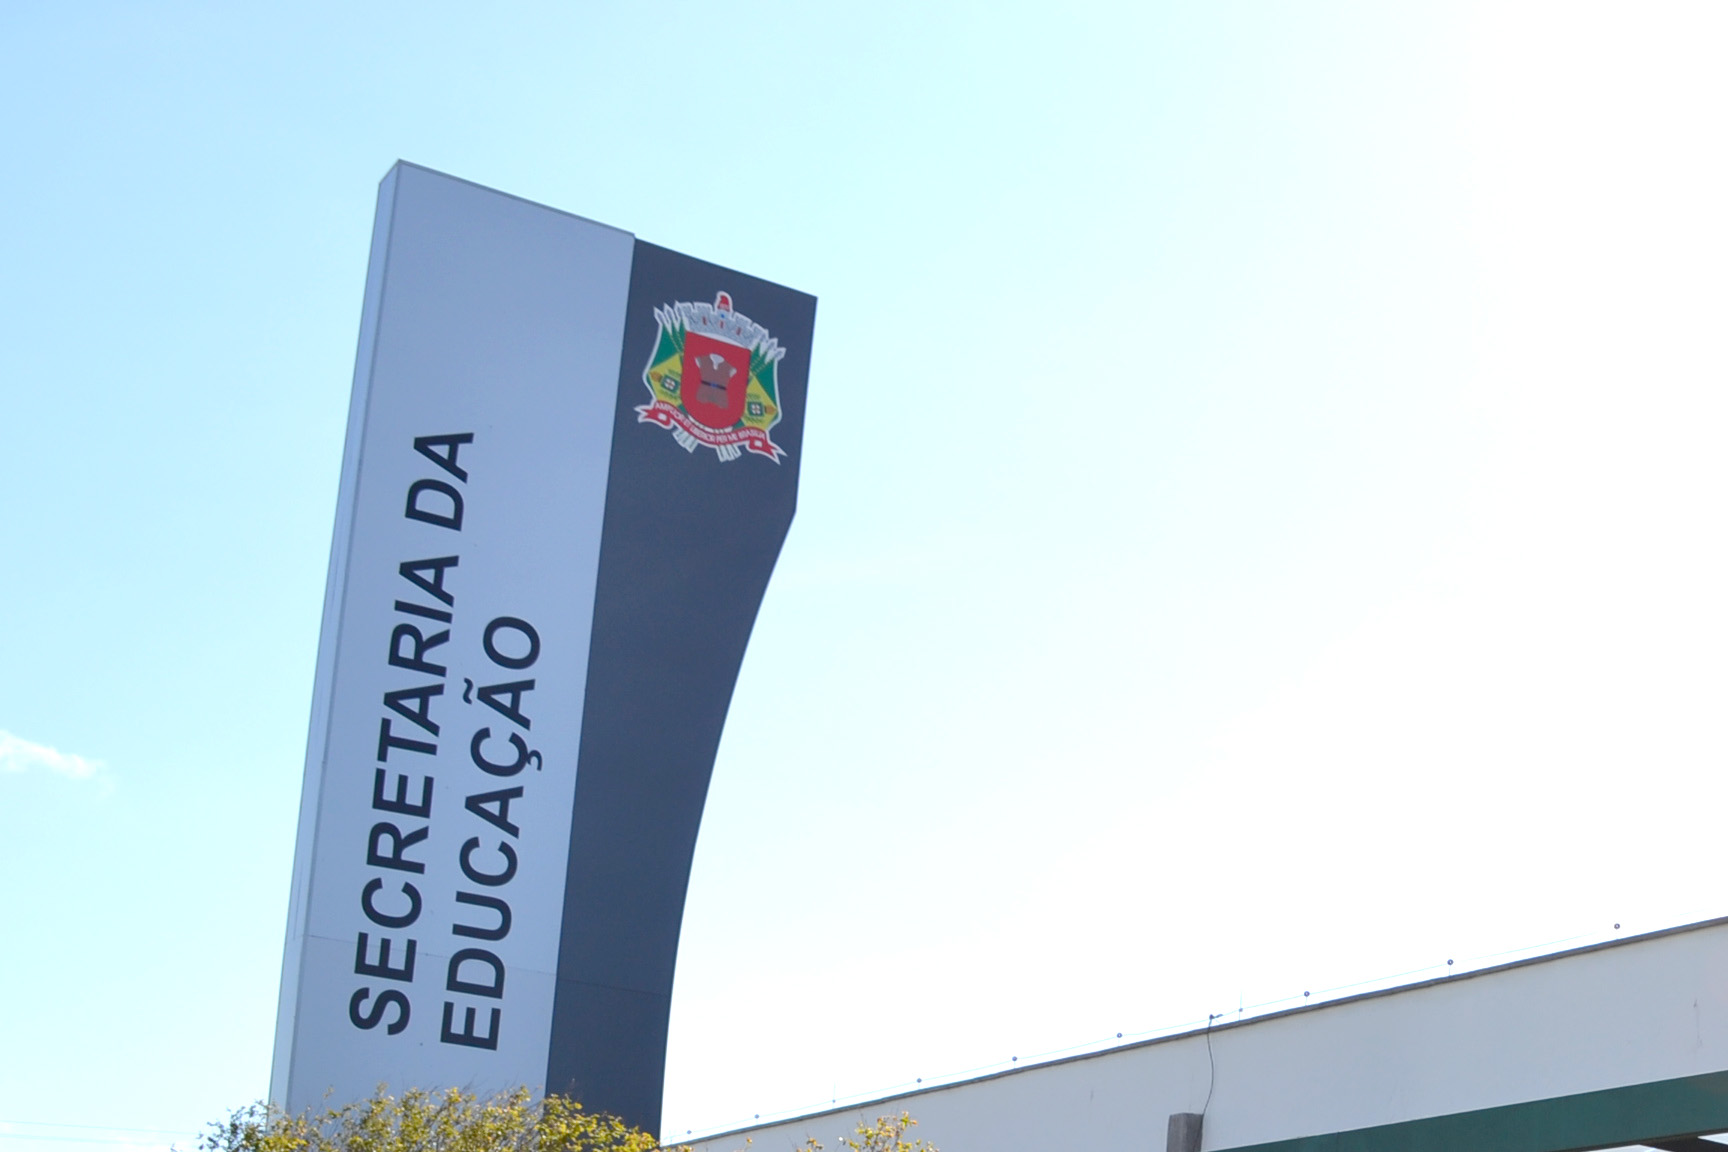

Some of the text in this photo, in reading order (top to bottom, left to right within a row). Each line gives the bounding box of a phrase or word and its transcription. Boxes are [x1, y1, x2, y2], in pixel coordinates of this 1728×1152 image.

[348, 431, 475, 1036] SECRETARIA DA
[439, 615, 543, 1052] EDUCAÇÃO
